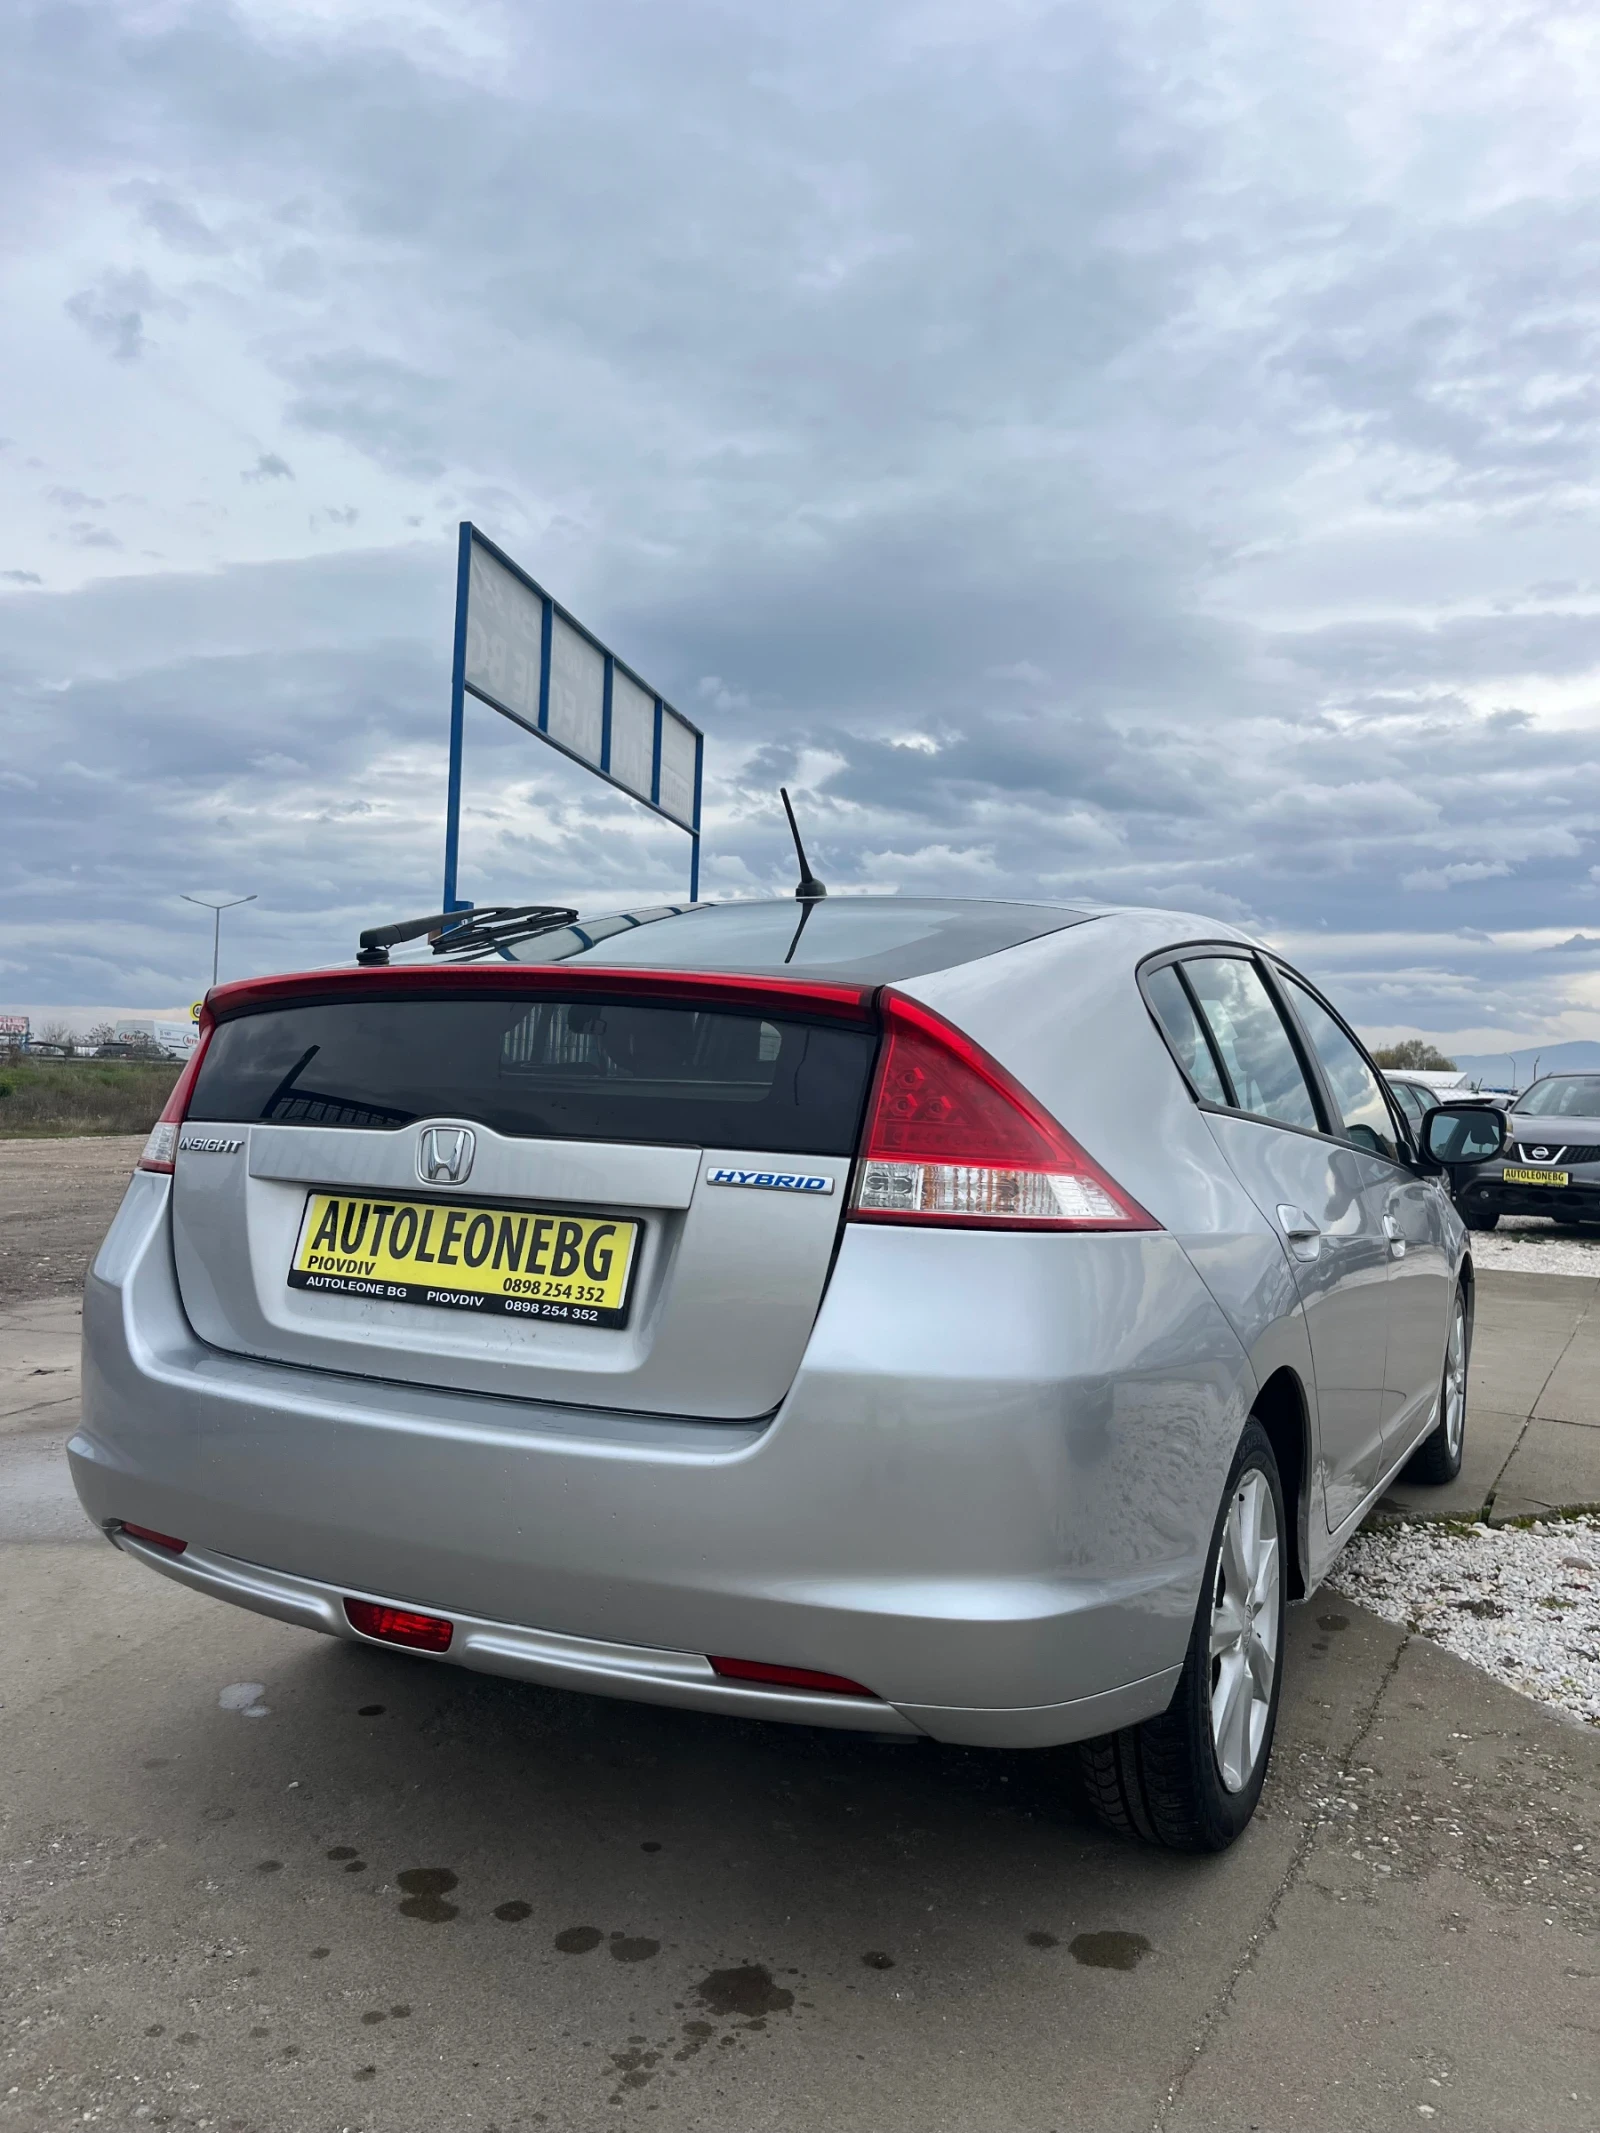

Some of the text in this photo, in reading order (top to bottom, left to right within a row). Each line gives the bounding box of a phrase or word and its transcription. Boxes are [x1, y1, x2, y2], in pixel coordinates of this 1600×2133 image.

[713, 1170, 826, 1190] HYBRID
[1505, 1169, 1564, 1181] AUTOLEONEBG
[310, 1200, 616, 1281] AUTOLEONEBG
[307, 1255, 376, 1276] PIOVDIV
[306, 1276, 599, 1321] AUTOLEONE BG PIOVDIV 0898 254 352
[503, 1277, 605, 1303] 0898 254 352
